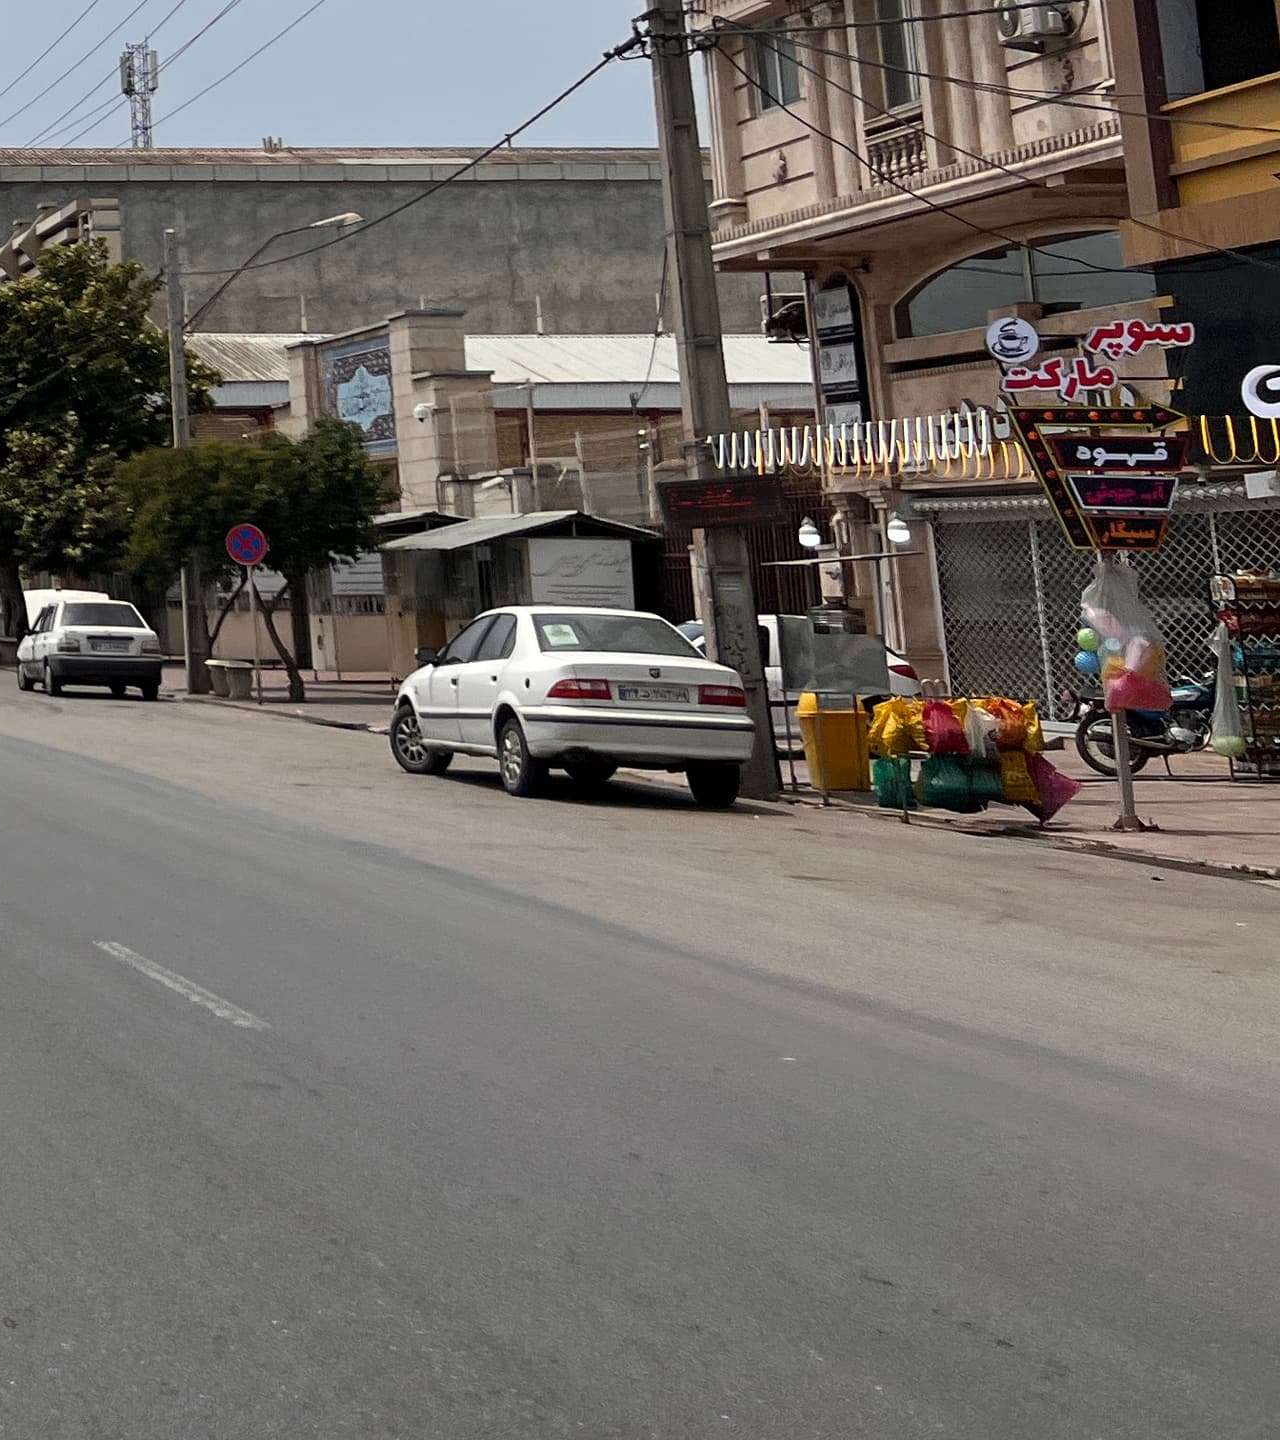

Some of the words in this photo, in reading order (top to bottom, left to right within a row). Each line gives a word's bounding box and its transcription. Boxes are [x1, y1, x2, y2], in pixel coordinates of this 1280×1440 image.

[1087, 319, 1194, 359] سوپر
[1001, 357, 1119, 403] مارکت
[1075, 441, 1169, 467] قهوه
